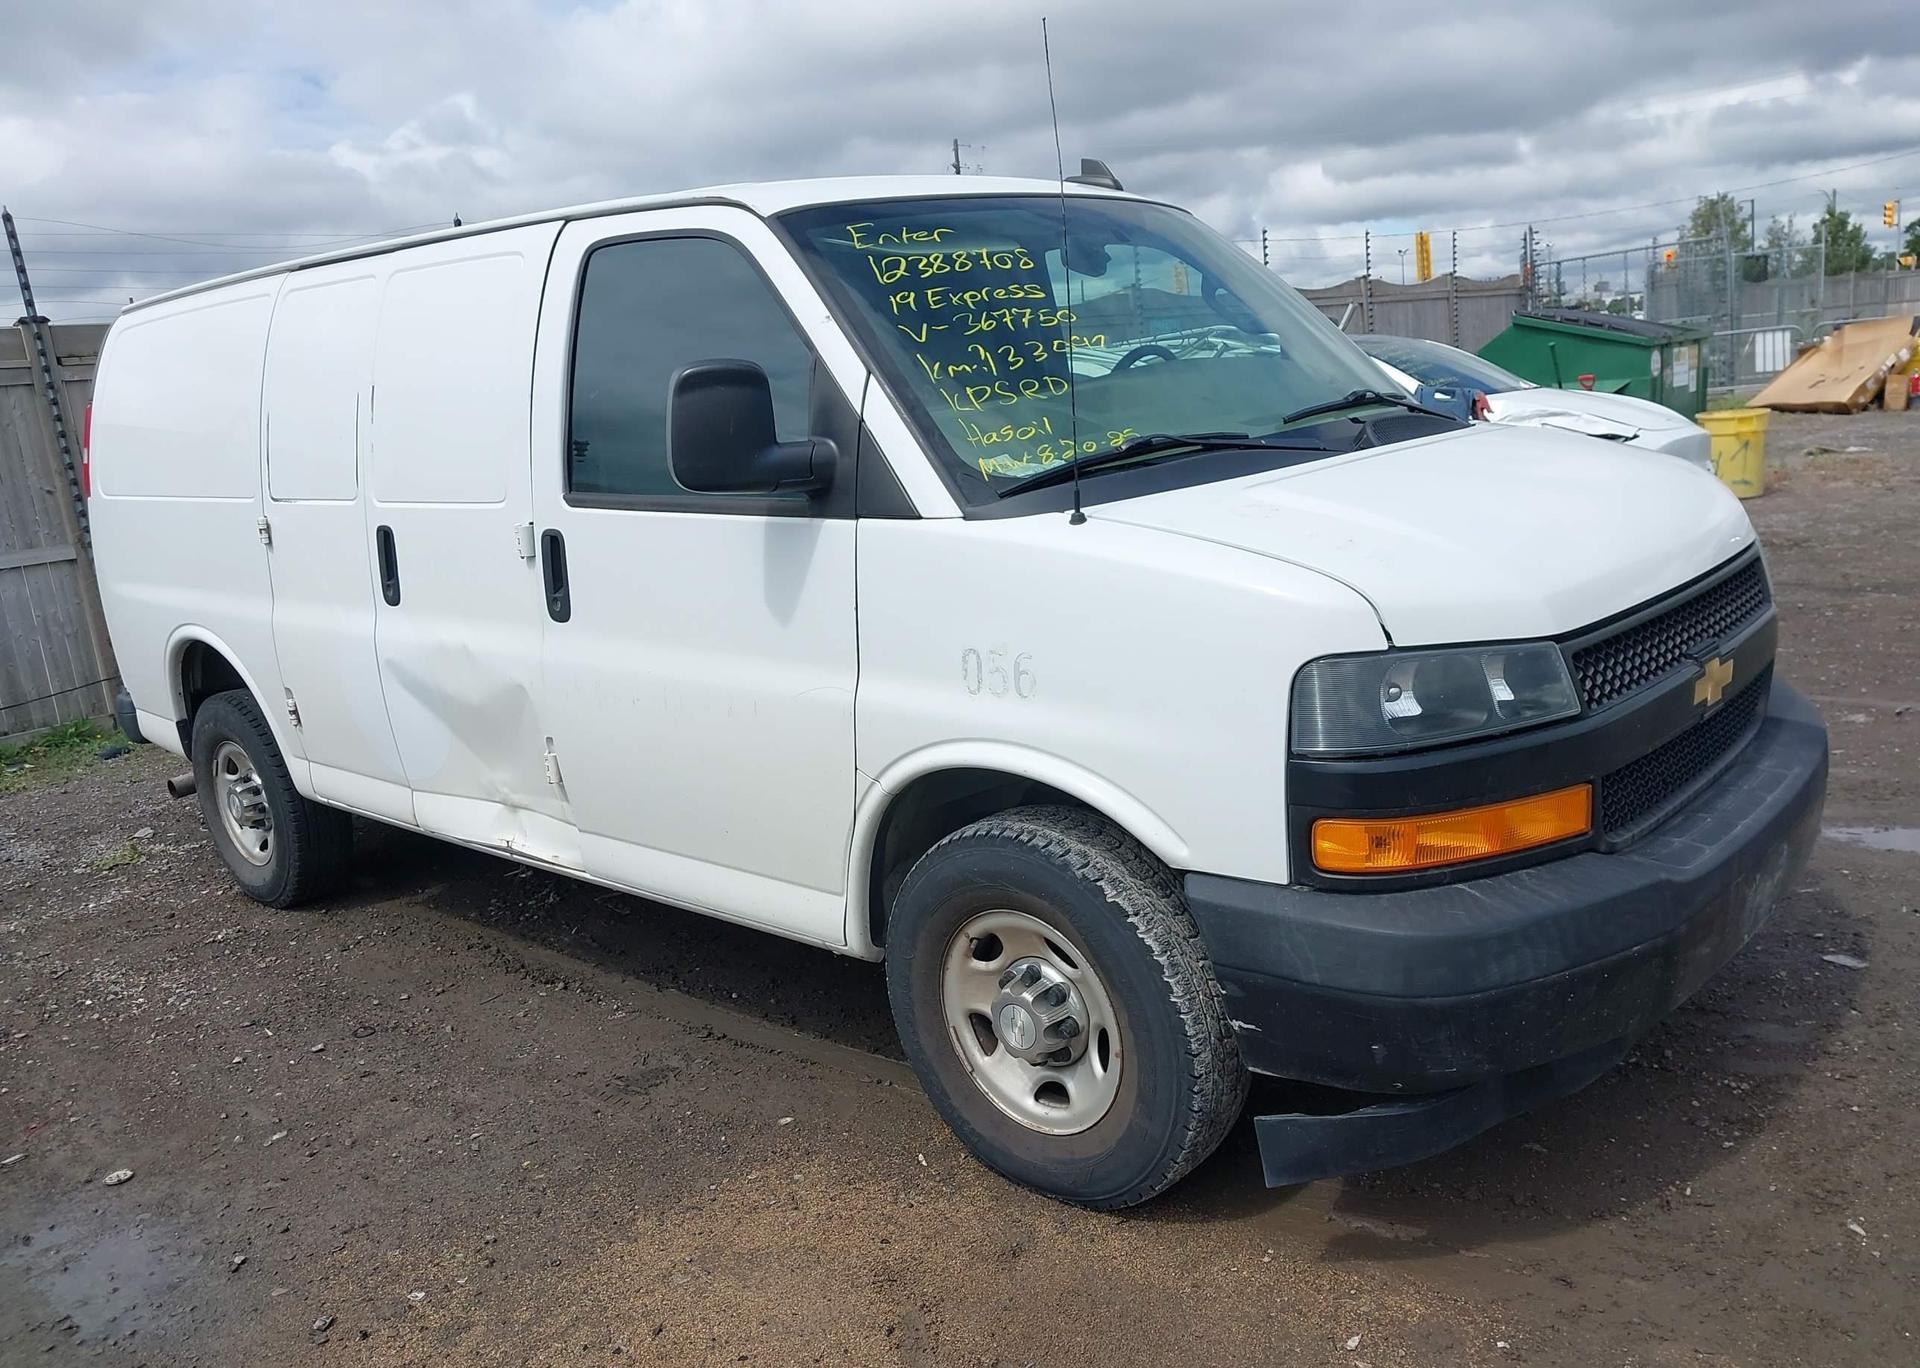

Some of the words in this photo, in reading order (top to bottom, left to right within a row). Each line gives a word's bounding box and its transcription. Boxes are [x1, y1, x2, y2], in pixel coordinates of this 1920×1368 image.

[846, 222, 955, 249] Enter
[867, 248, 1035, 285] 12388708
[889, 290, 919, 316] 19
[924, 284, 1047, 310] Express
[960, 646, 1038, 700] 056
